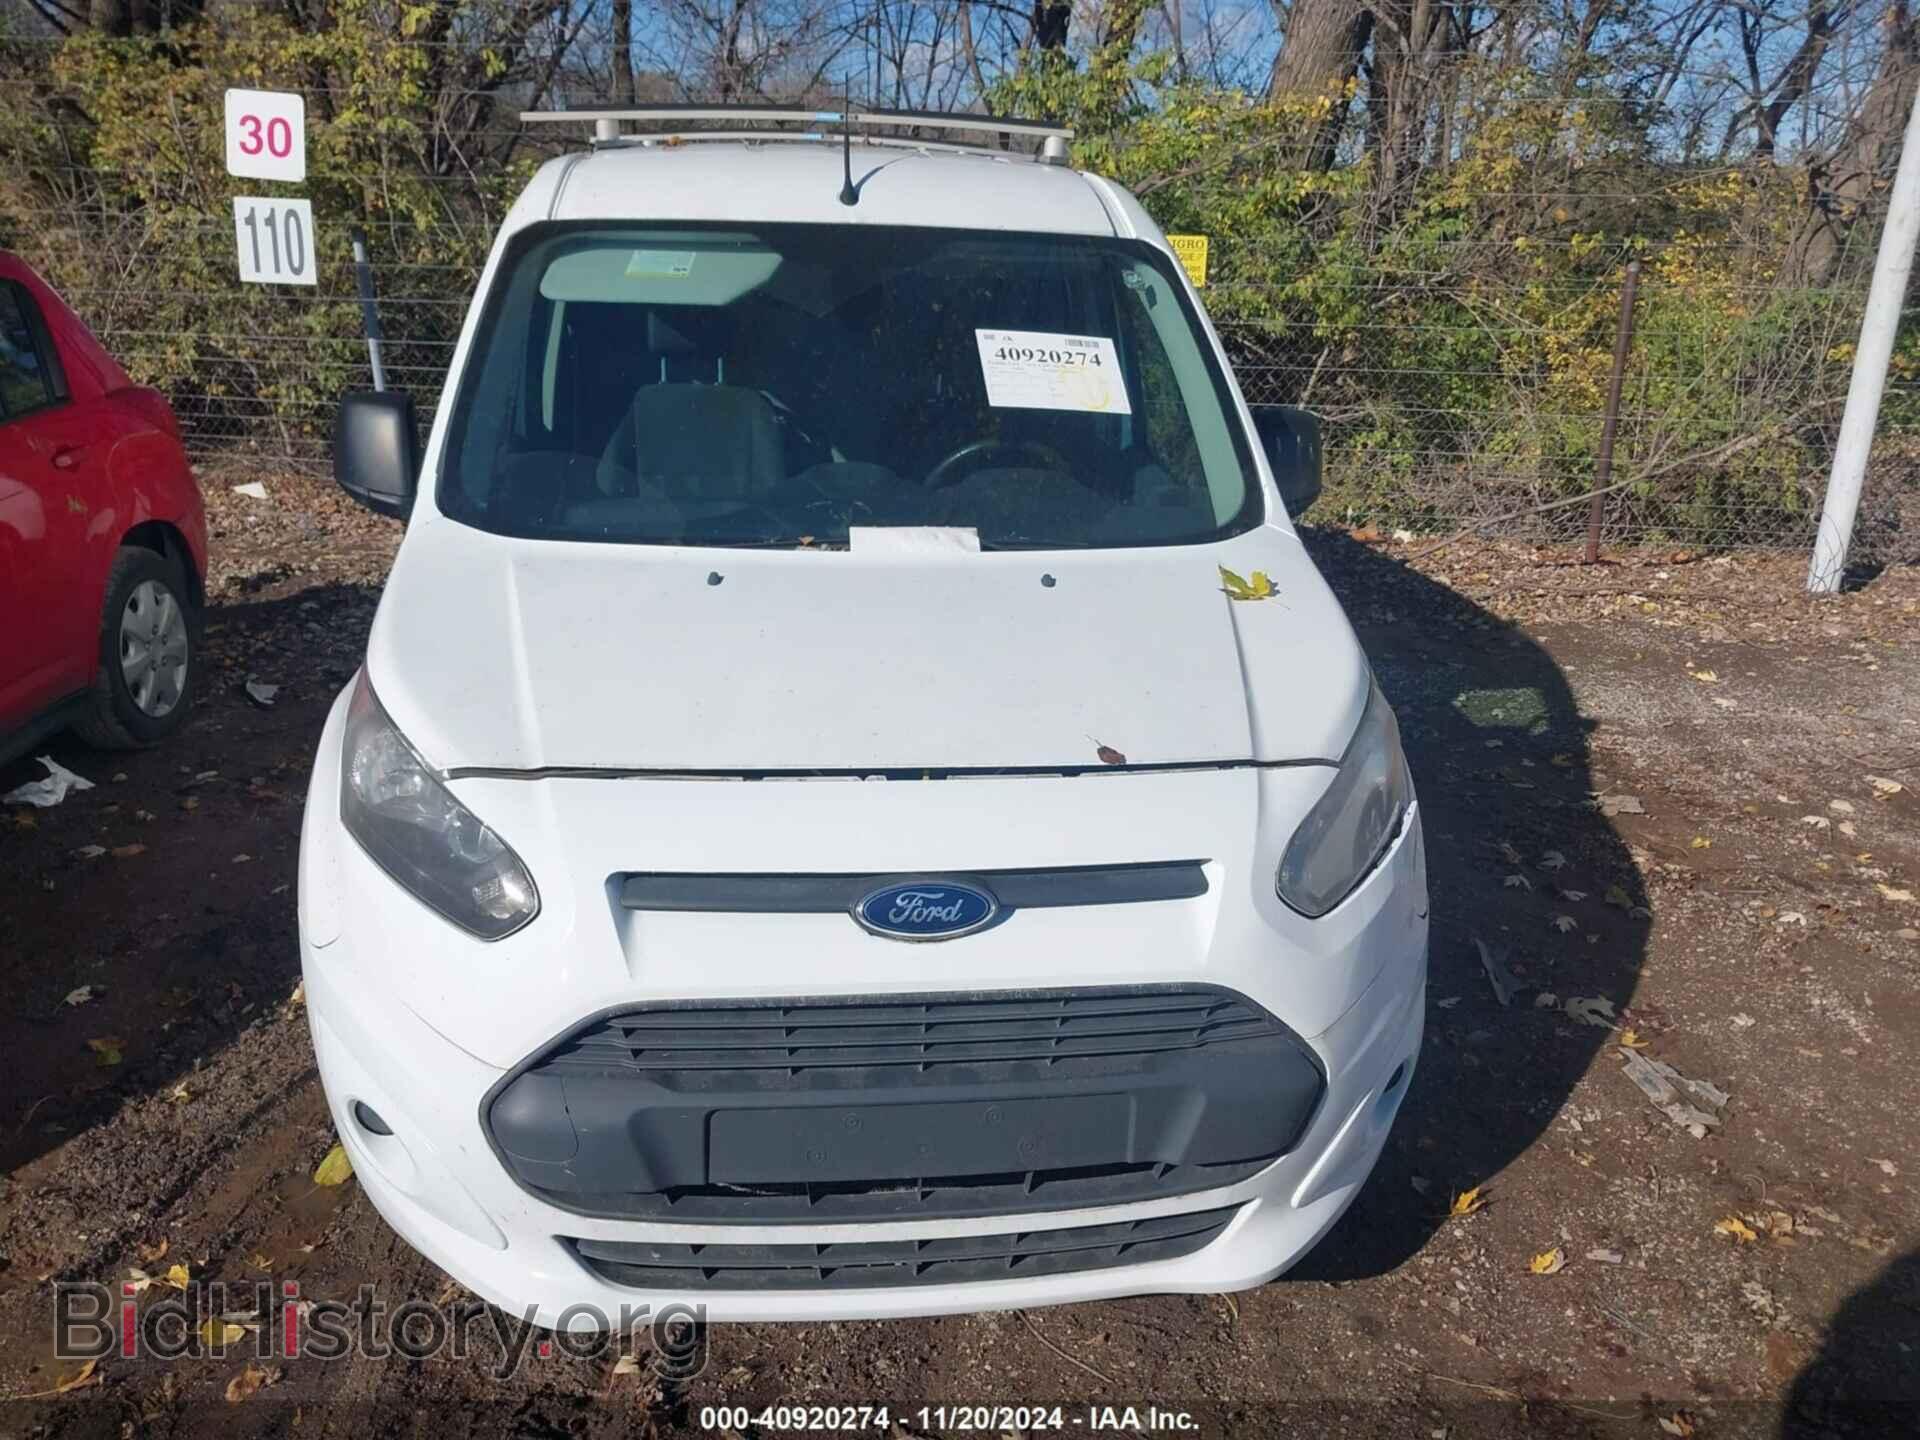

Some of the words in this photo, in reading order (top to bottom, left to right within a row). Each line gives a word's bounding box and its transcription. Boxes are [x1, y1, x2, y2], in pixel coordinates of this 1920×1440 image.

[238, 114, 293, 159] 30
[244, 206, 305, 276] 110
[995, 347, 1102, 367] 40920274
[888, 891, 963, 924] Ford
